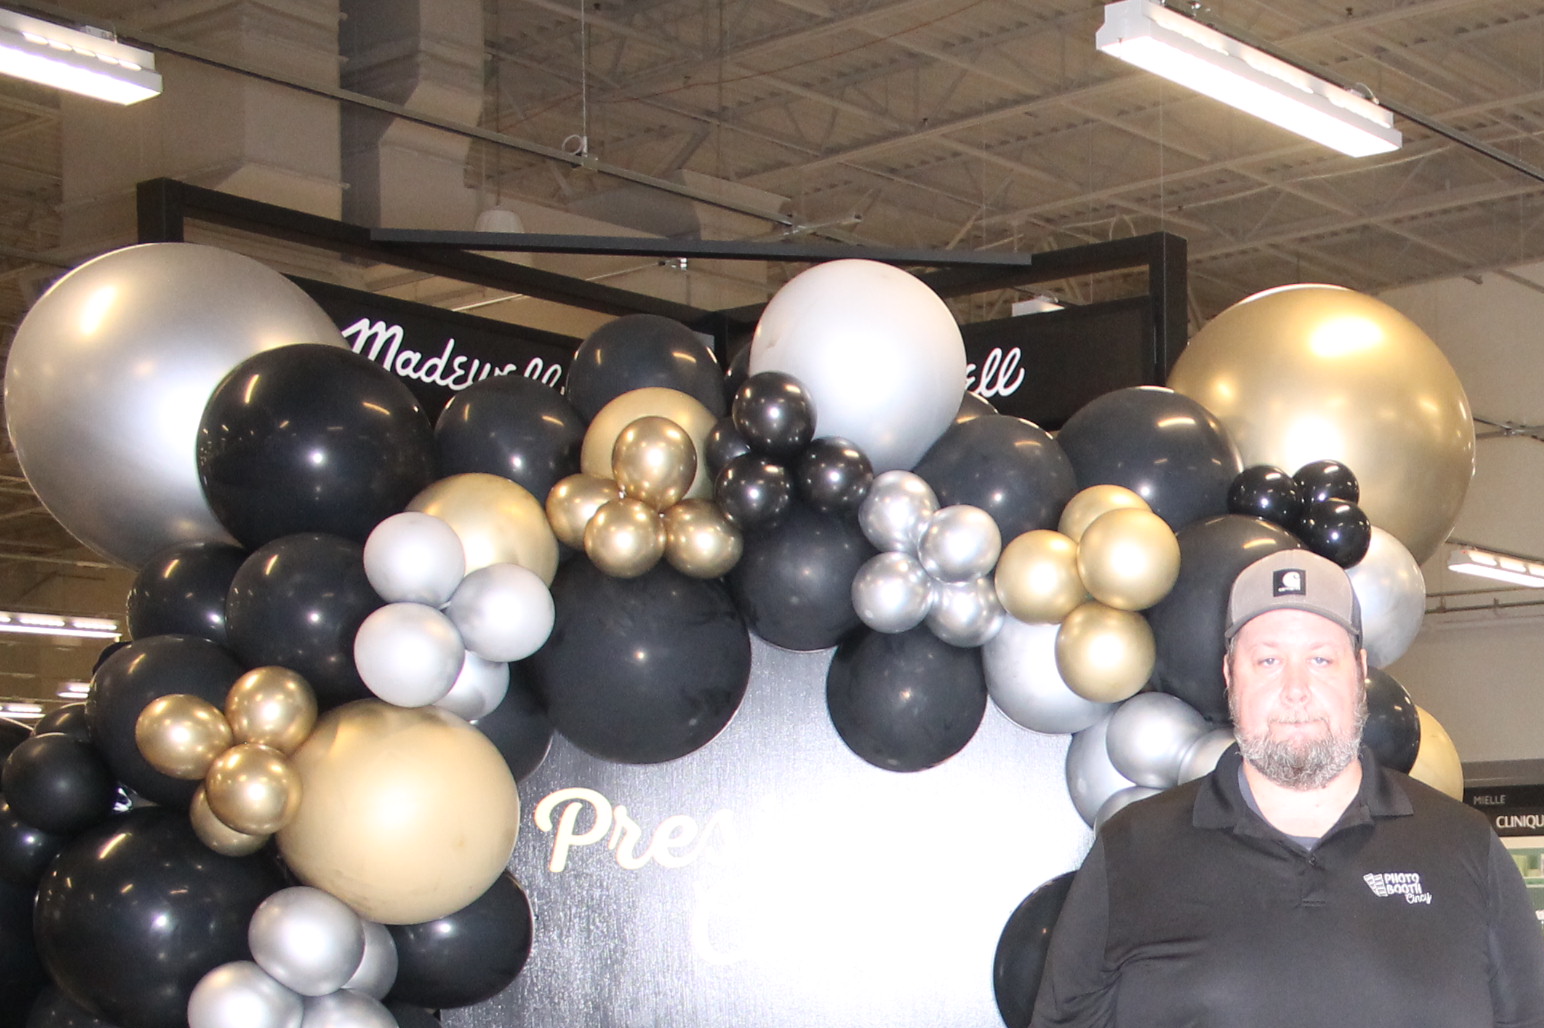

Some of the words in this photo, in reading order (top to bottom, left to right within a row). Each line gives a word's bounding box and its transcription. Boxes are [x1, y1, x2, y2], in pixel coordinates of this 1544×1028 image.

[1473, 794, 1506, 805] MIELLE
[1384, 872, 1420, 884] PHOTO
[1386, 883, 1422, 895] BOOTH
